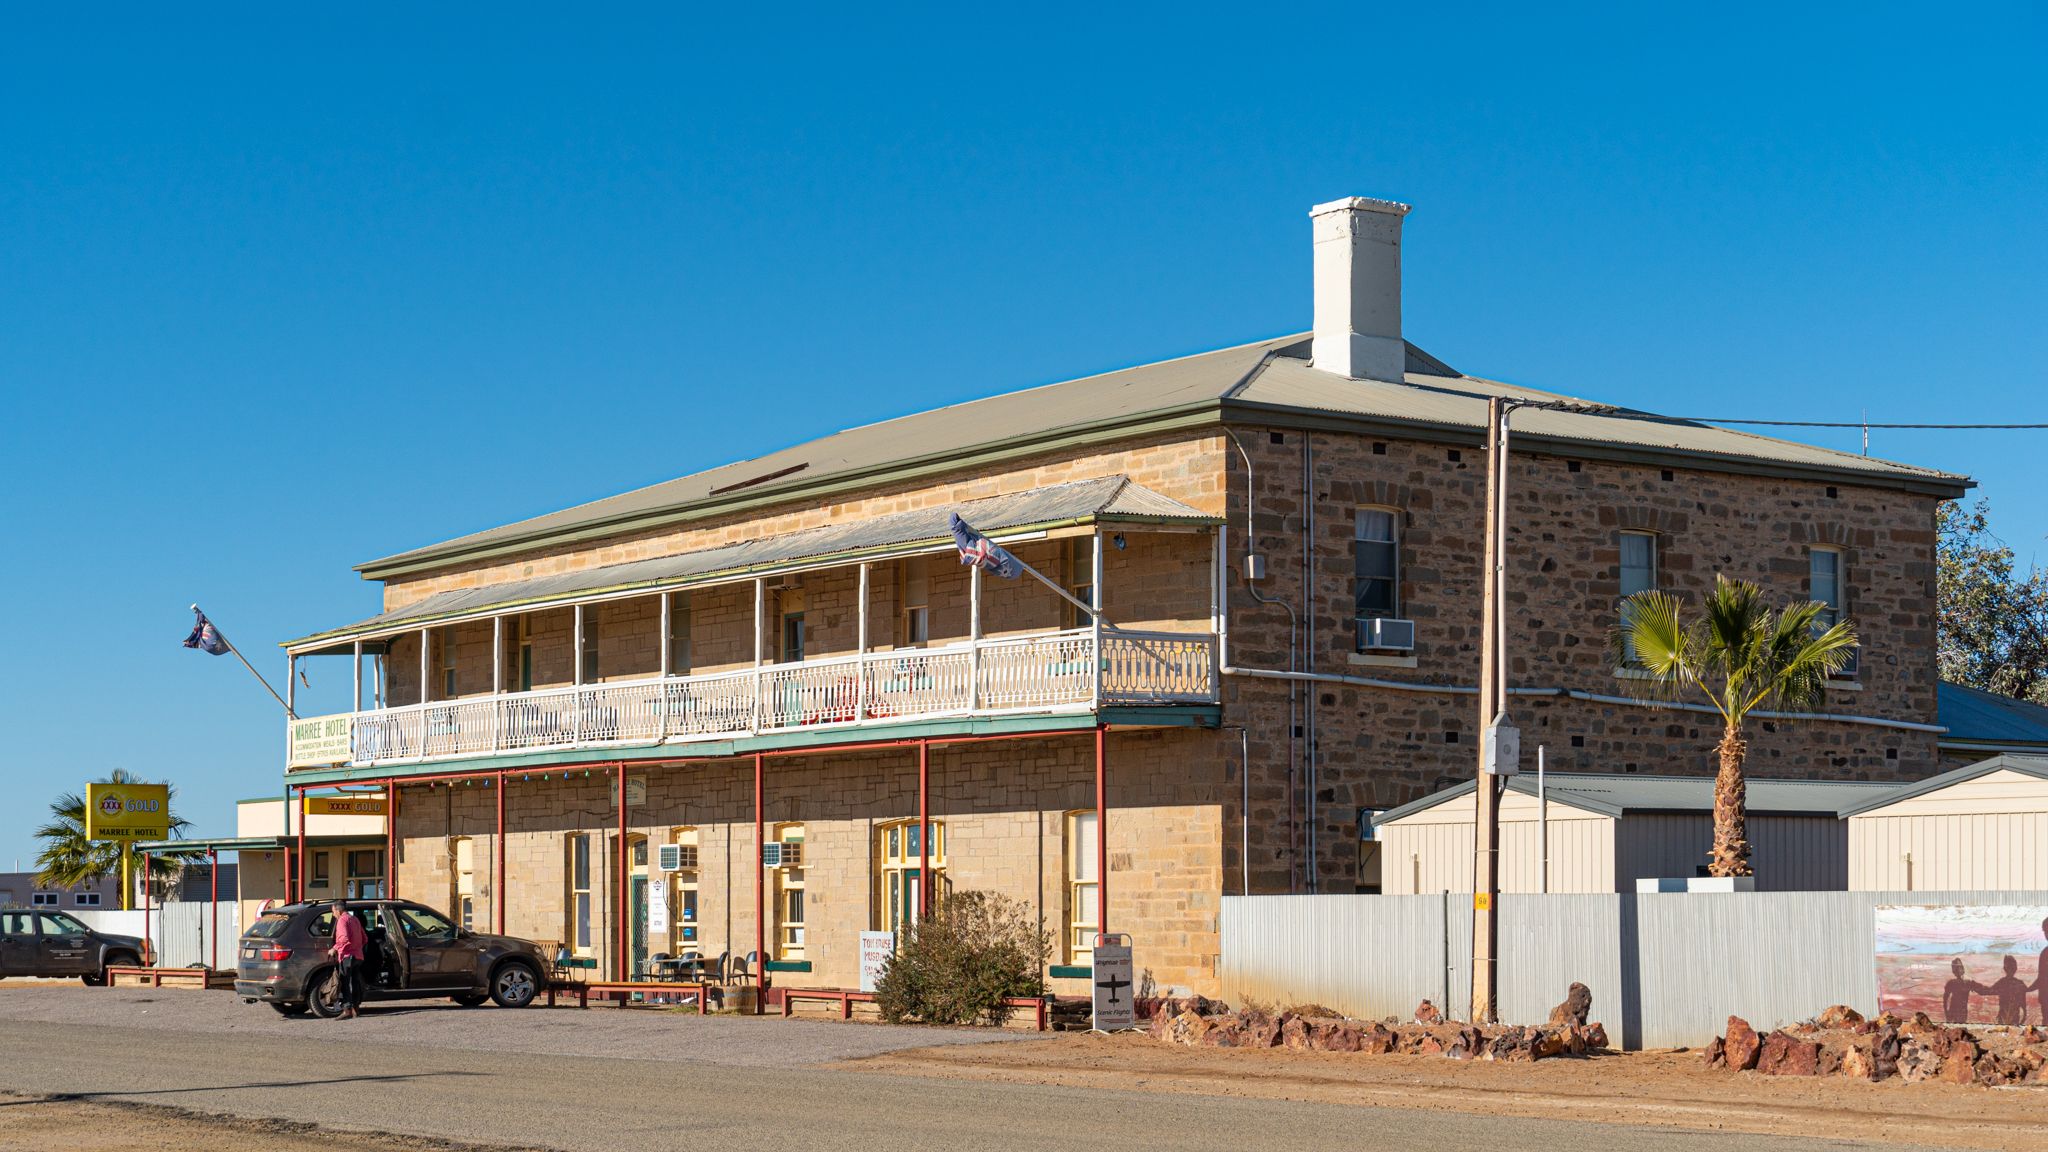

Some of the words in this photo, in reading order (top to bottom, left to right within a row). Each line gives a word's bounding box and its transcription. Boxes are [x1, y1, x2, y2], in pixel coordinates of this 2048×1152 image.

[295, 722, 321, 741] MARREE
[325, 718, 347, 737] HOTEL
[100, 801, 122, 810] XXXX
[125, 799, 160, 812] GOLD
[329, 802, 352, 811] XXXX
[354, 801, 381, 812] GOLD
[99, 828, 131, 837] MARREE
[134, 828, 159, 837] HOTEL
